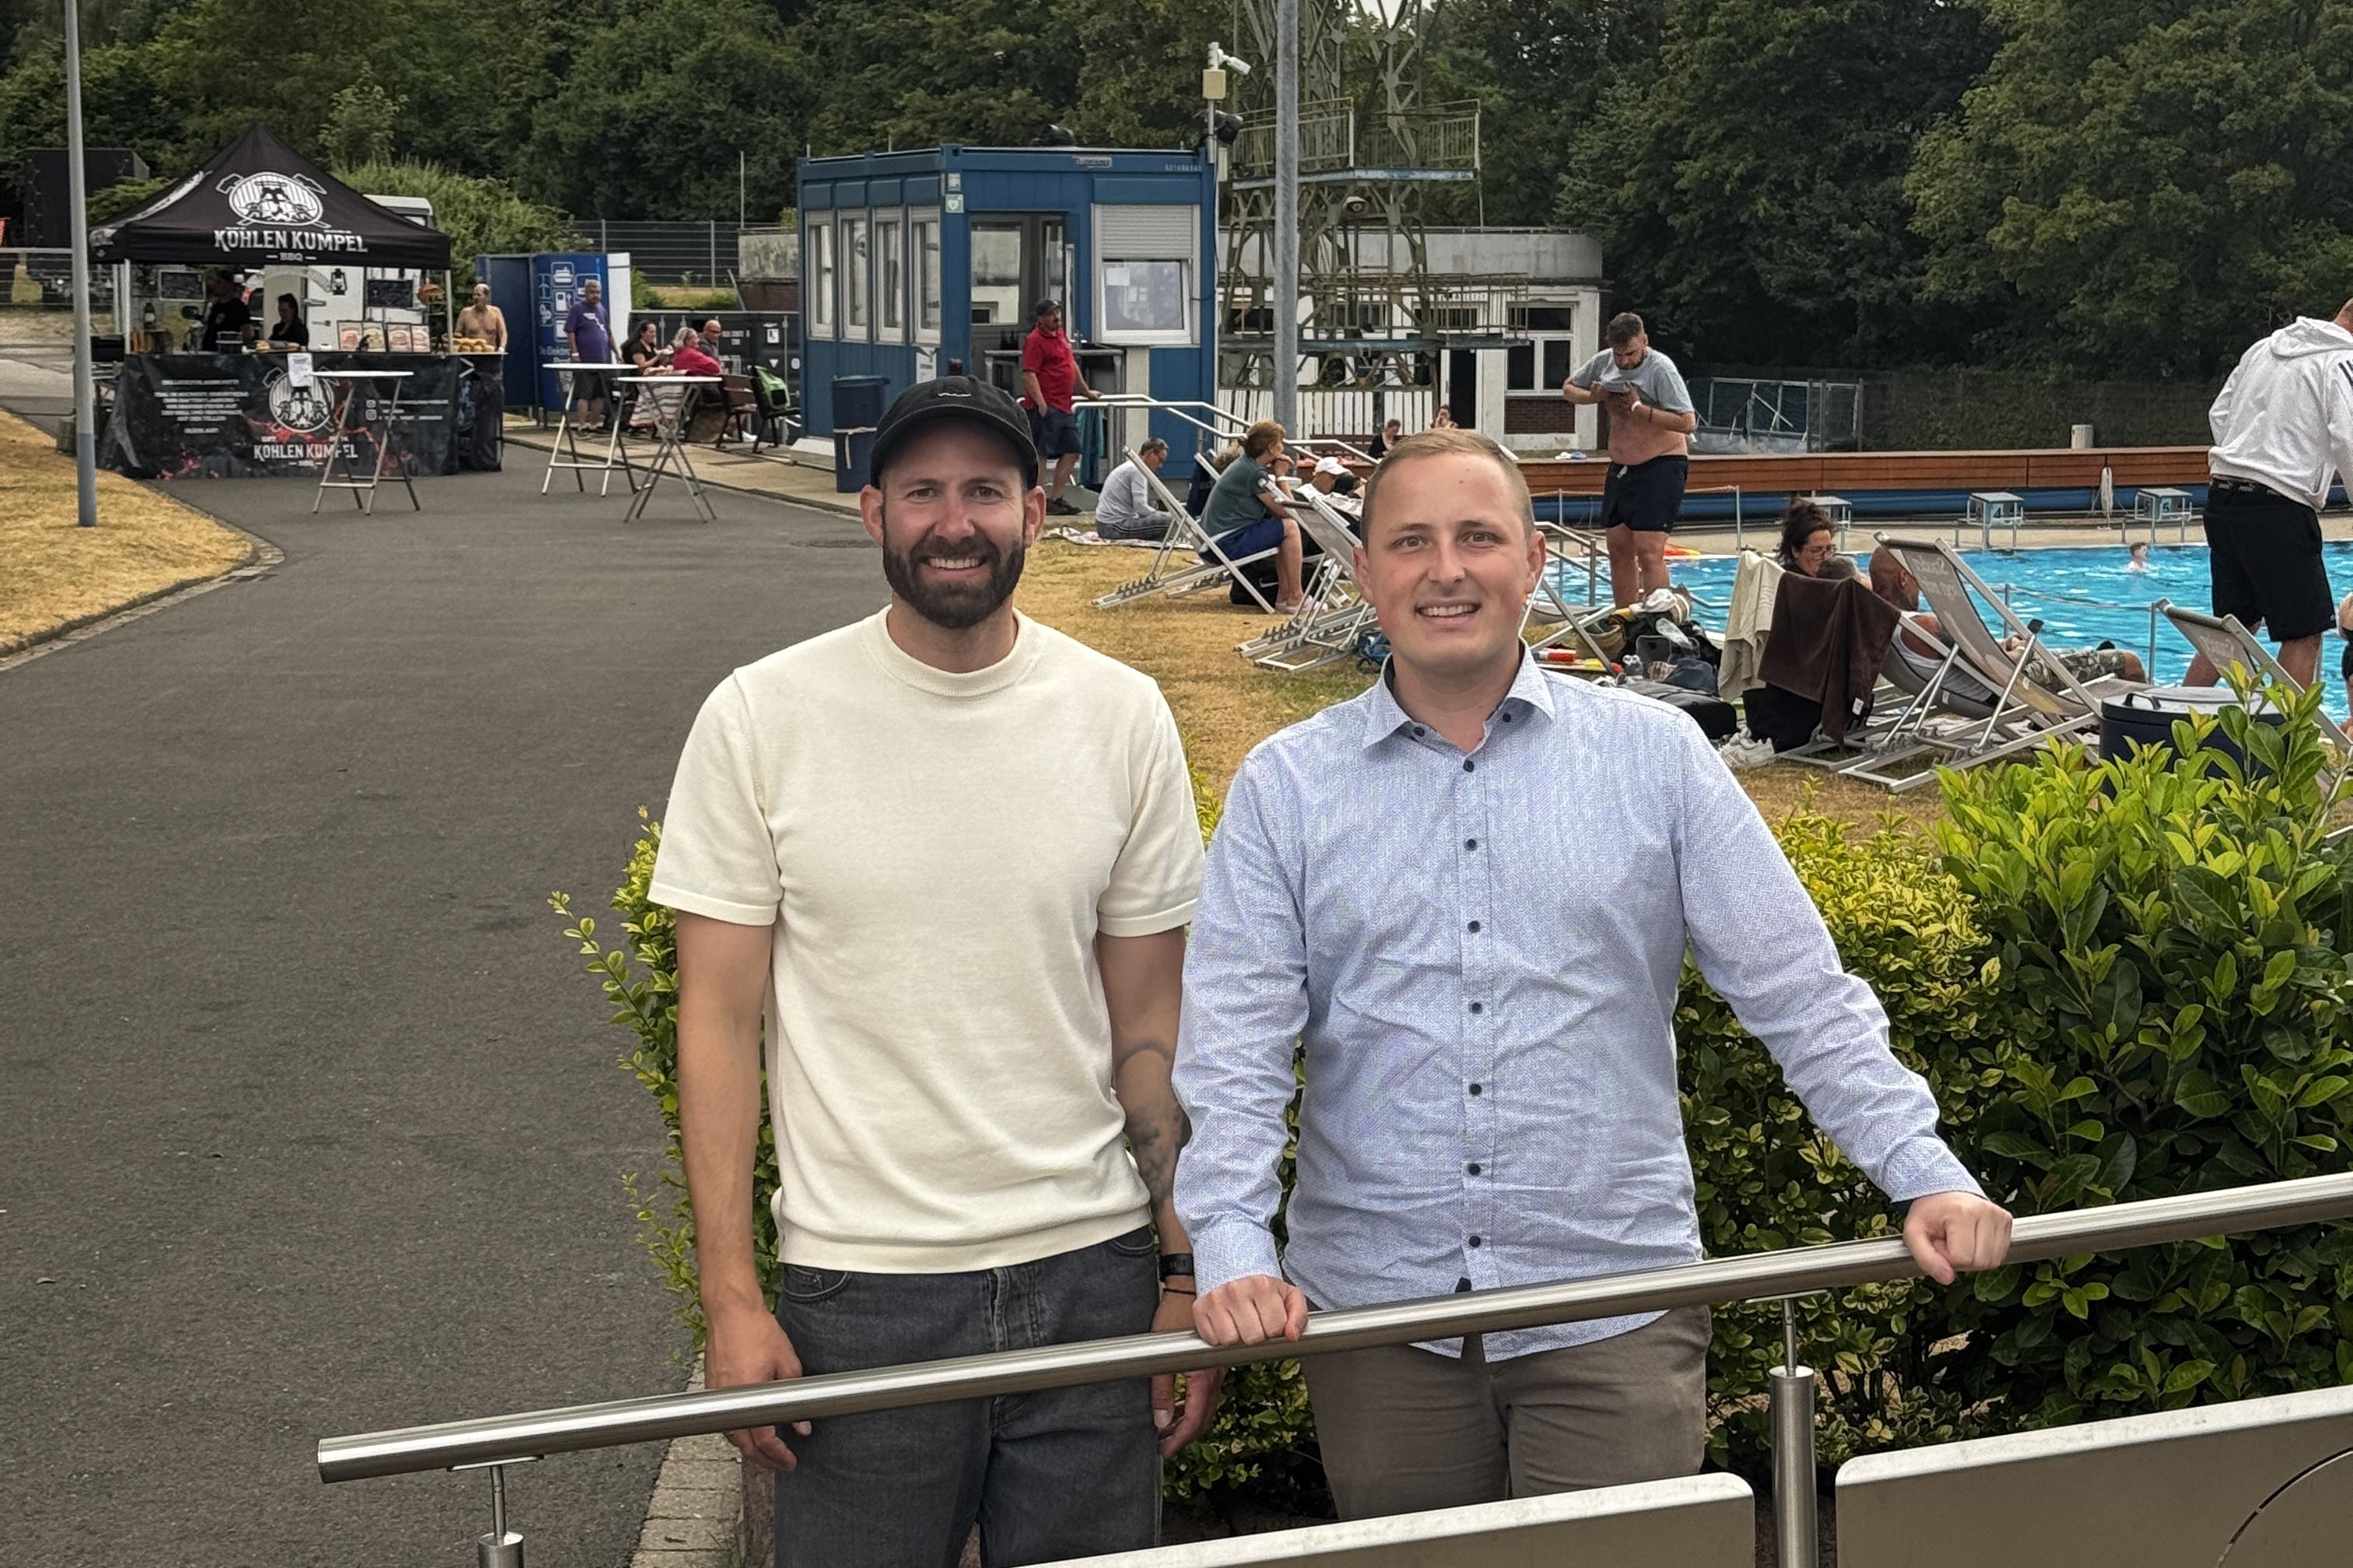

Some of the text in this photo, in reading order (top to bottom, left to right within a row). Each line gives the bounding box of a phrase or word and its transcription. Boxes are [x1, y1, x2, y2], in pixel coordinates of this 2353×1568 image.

[213, 230, 369, 253] KOHLEN KUMPEL
[279, 251, 303, 262] BBQ
[253, 444, 304, 462] KOHLEN
